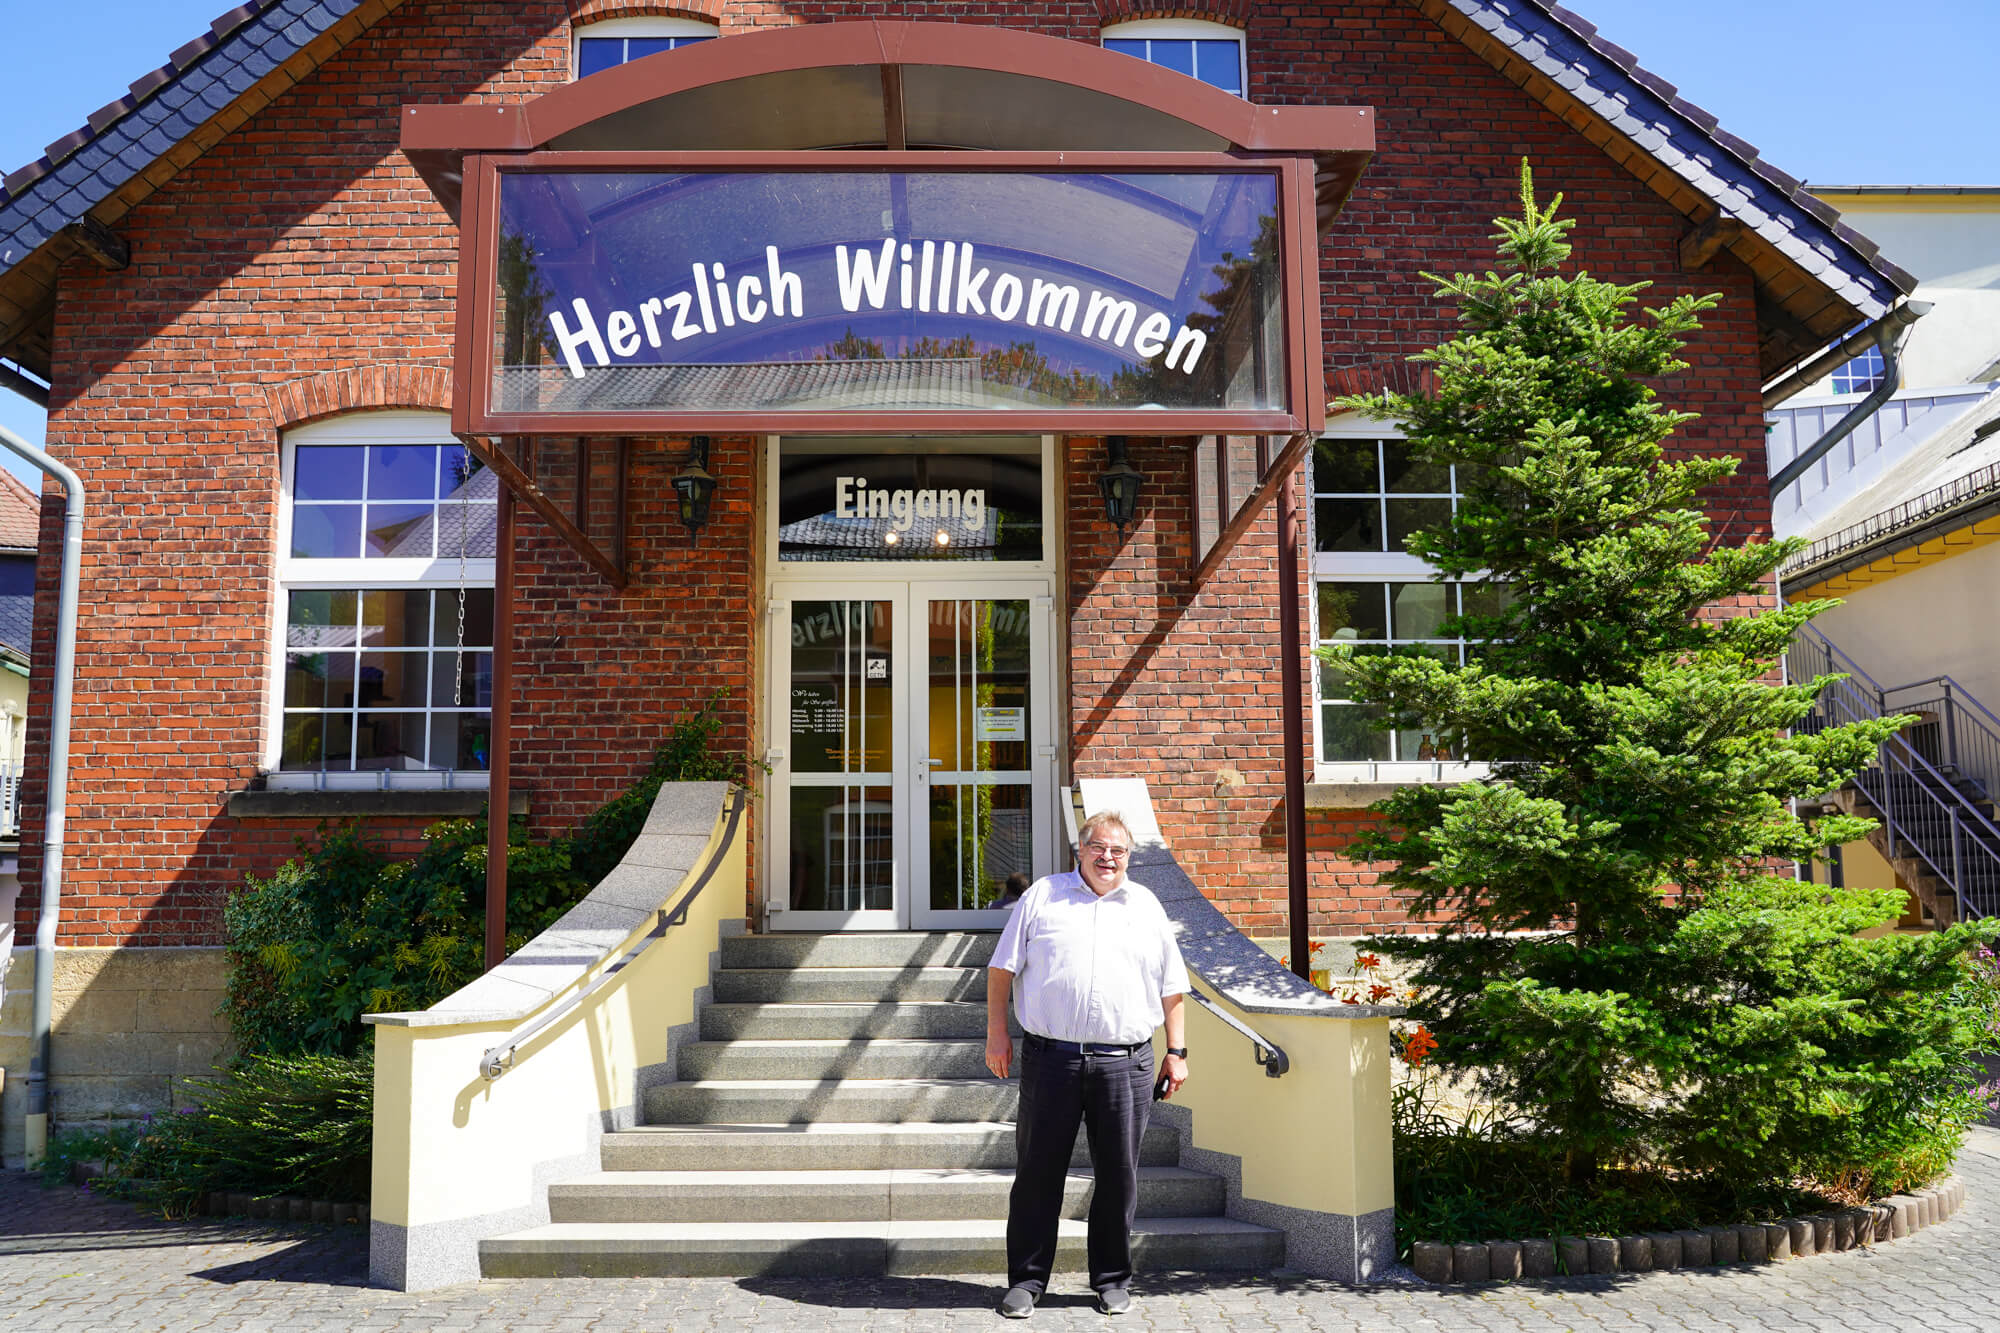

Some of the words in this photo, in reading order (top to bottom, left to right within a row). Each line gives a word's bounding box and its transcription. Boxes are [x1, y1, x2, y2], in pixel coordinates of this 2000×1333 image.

[549, 245, 804, 380] Herzlich
[835, 237, 1208, 375] Willkommen
[835, 476, 986, 531] Eingang
